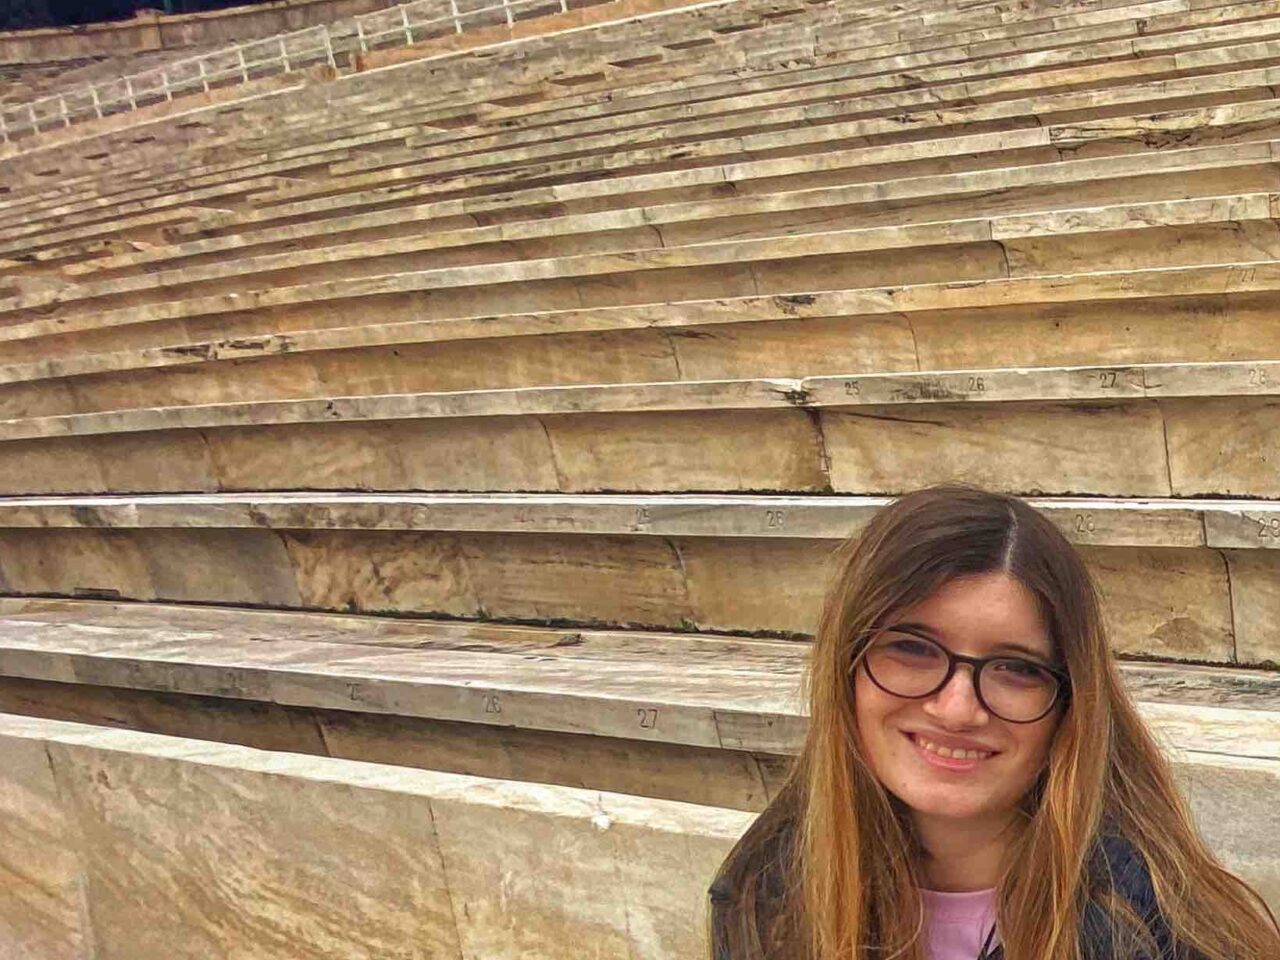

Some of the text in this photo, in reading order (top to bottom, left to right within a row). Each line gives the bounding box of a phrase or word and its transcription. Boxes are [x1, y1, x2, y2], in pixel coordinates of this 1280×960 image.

[844, 380, 860, 396] 25
[967, 377, 985, 393] 26
[1100, 372, 1117, 389] 27
[637, 707, 658, 729] 27
